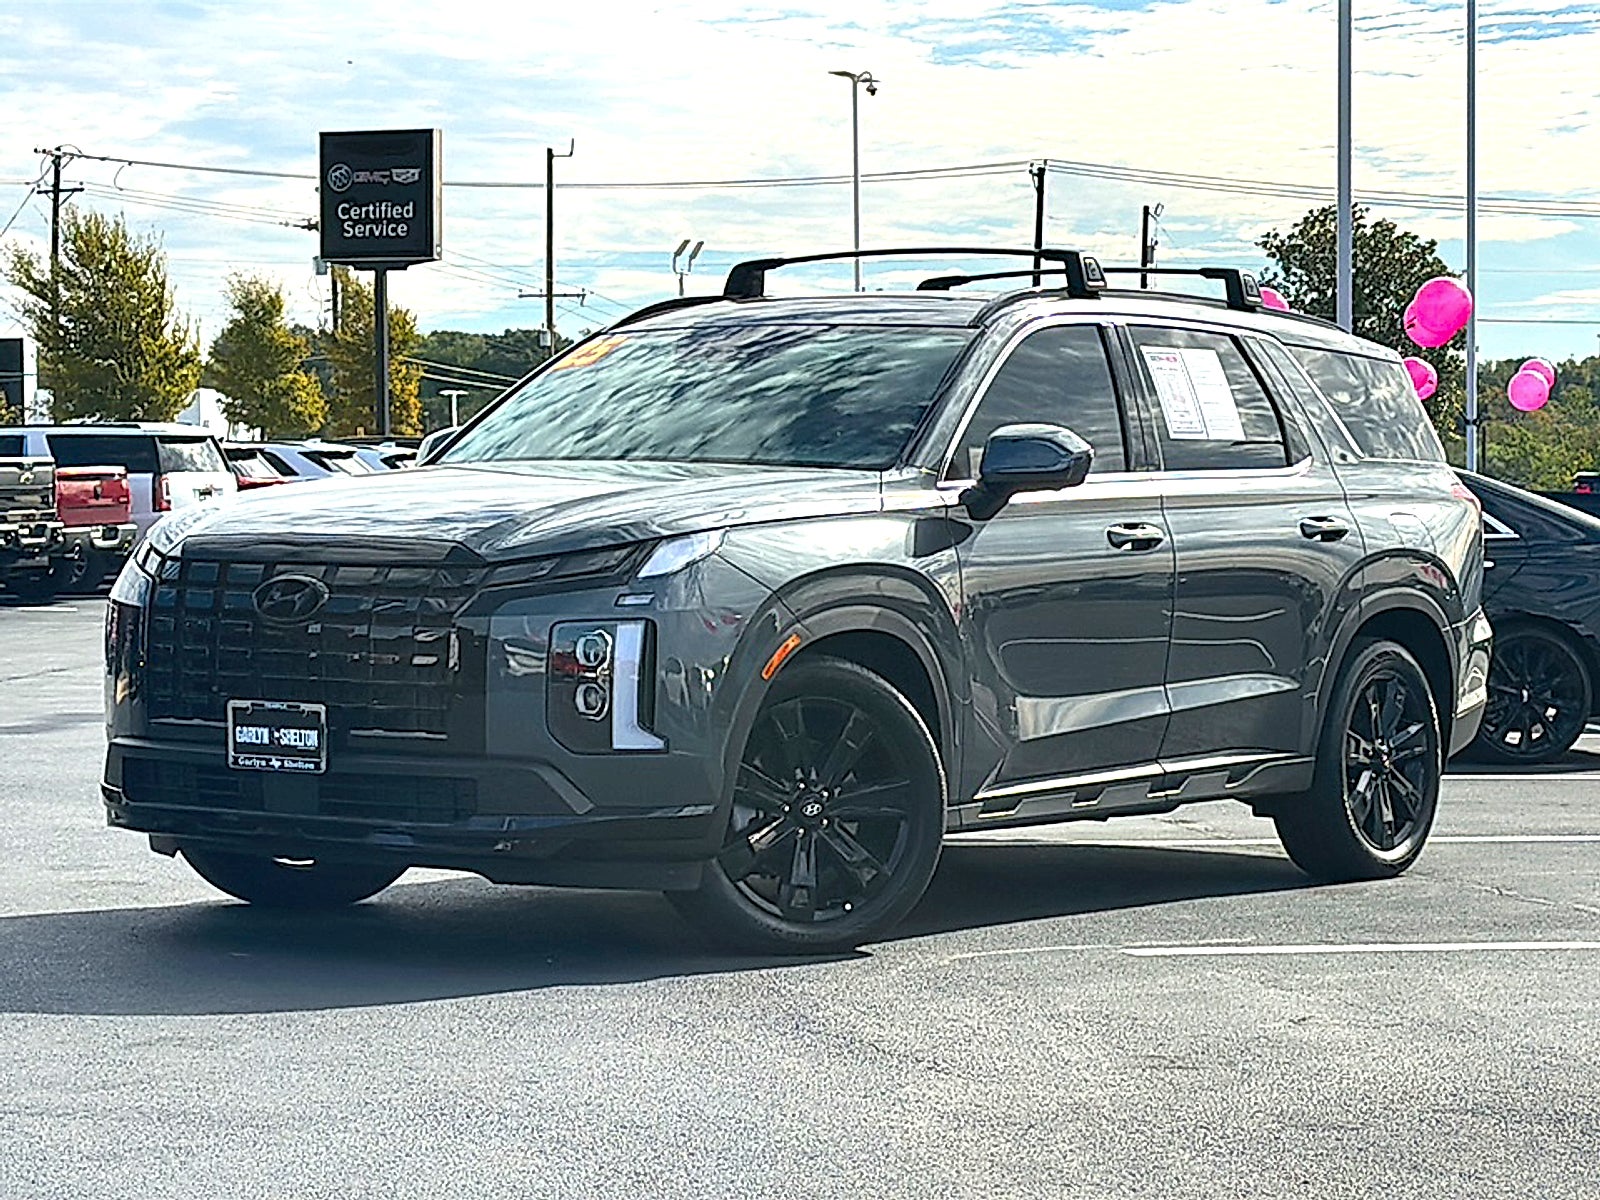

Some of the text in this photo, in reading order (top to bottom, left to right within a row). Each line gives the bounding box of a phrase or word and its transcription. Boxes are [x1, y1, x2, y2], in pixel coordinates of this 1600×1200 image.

[337, 202, 414, 219] Certified
[343, 220, 408, 238] Service
[279, 728, 319, 747] SHELTON
